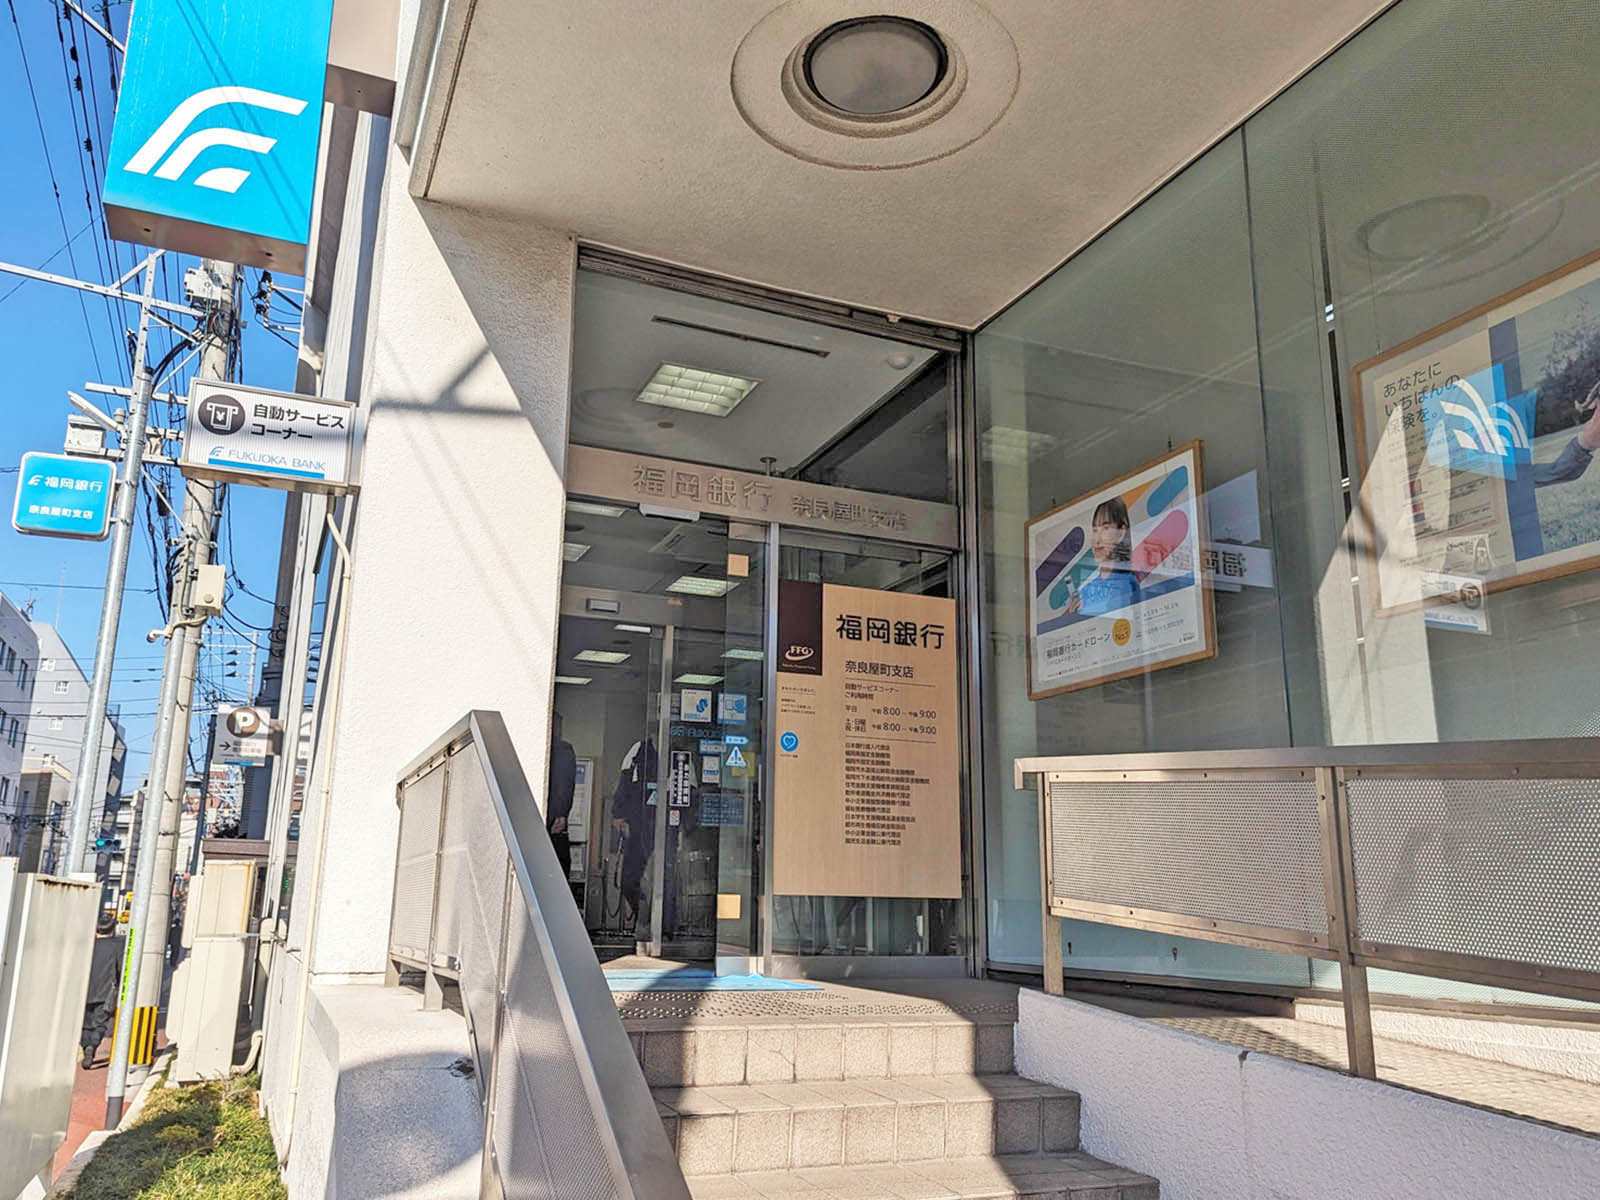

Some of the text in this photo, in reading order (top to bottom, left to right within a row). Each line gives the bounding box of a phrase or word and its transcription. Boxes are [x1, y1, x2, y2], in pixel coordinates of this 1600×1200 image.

[1384, 362, 1442, 398] あなたに
[1384, 374, 1461, 416] いちばんの
[253, 404, 344, 429] 自動サービス
[251, 423, 313, 440] コーナー
[228, 451, 326, 471] FUKUOKA BANK
[45, 476, 104, 493] 福岡銀行
[633, 463, 776, 514] 福岡銀行
[791, 493, 909, 530] 奈良屋町支店
[836, 614, 945, 649] 福岡銀行
[790, 645, 809, 655] FFG
[845, 660, 914, 679] 奈良屋町支店
[845, 683, 900, 694] 自動サービスコーナー
[234, 712, 255, 734] P
